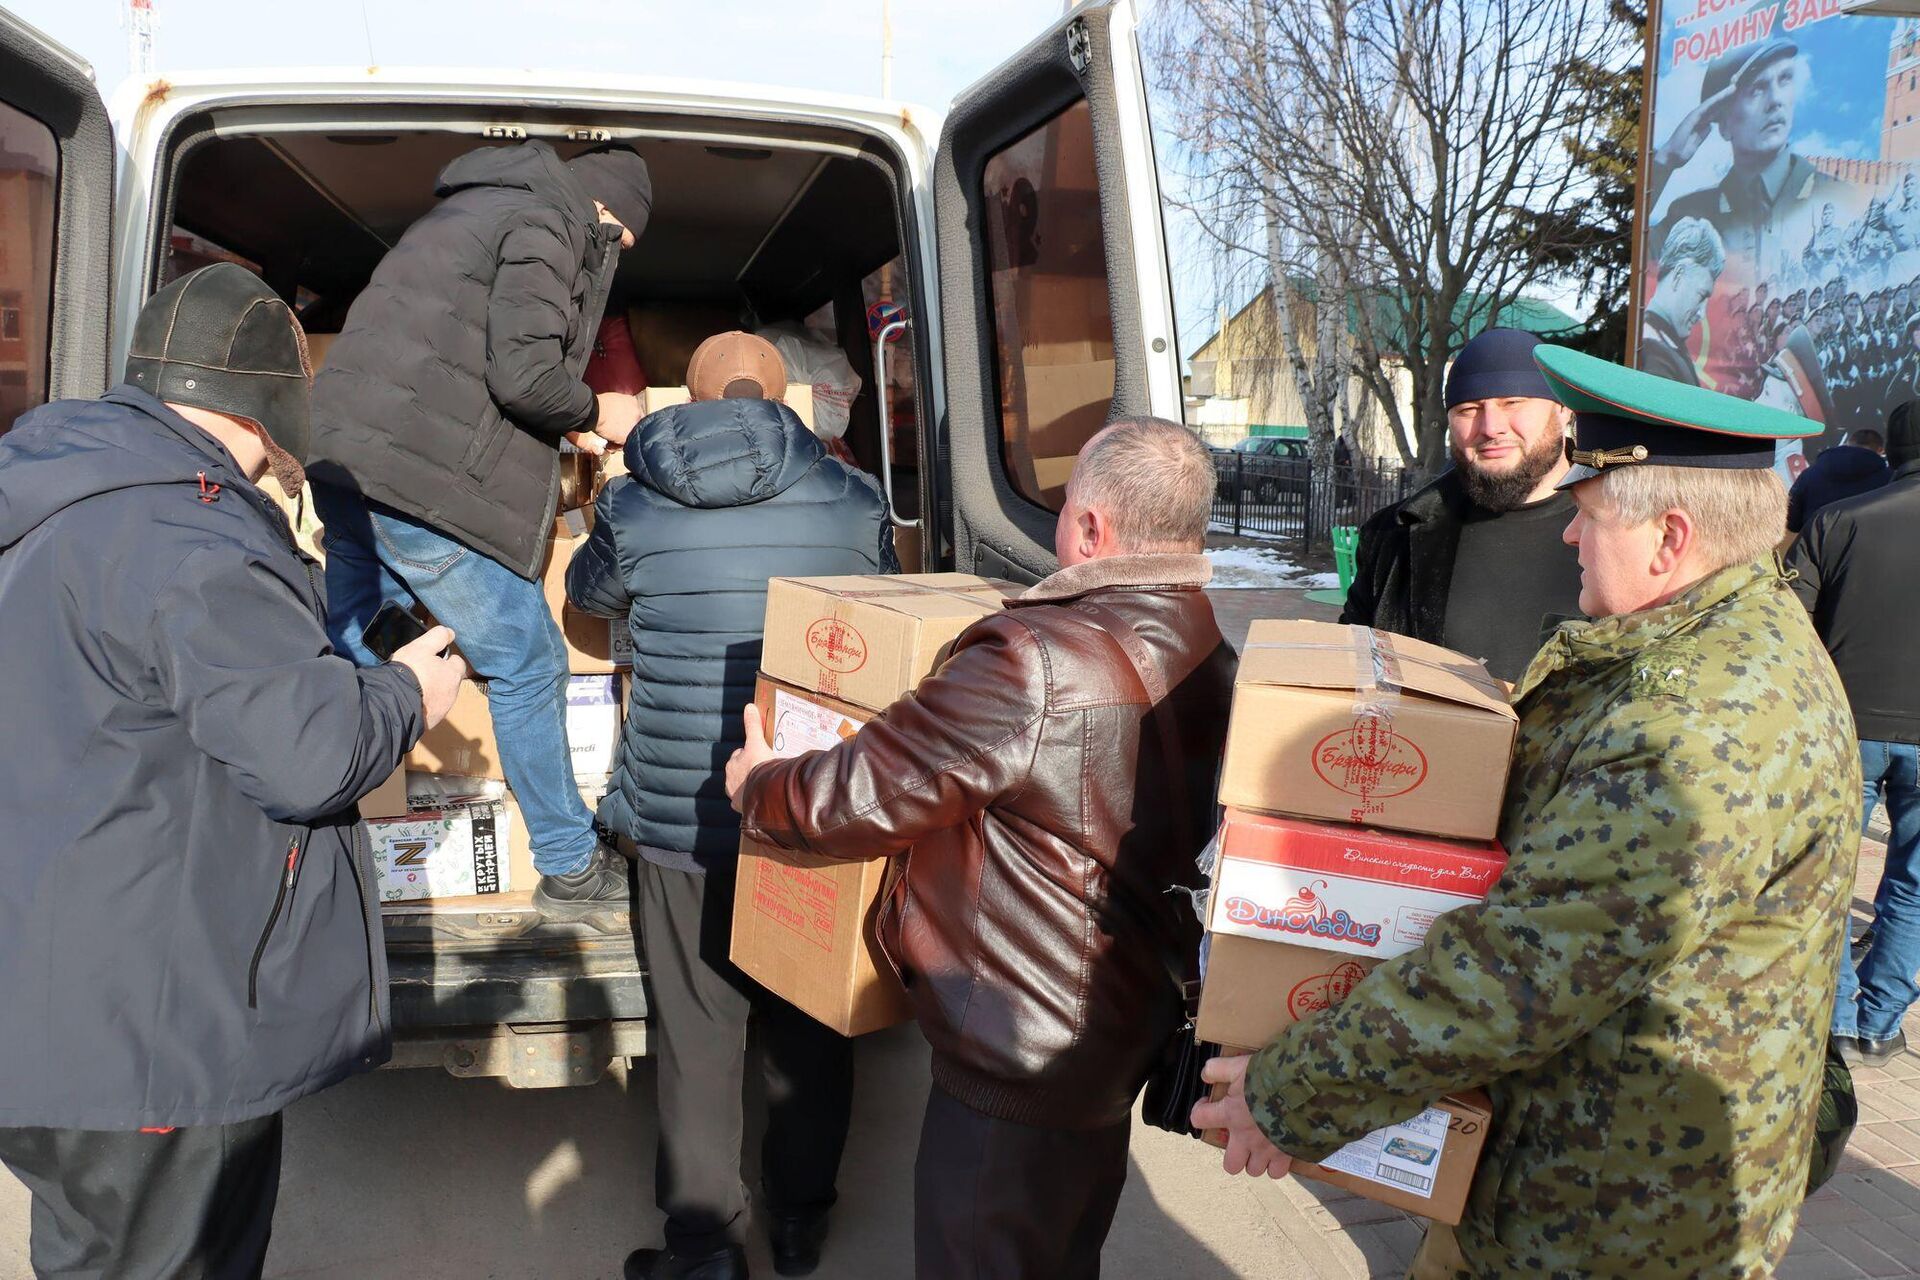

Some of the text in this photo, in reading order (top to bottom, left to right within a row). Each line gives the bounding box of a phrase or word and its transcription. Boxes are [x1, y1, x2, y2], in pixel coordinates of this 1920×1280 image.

[1673, 6, 1778, 66] РОДИНУ
[474, 836, 487, 883] КРУТЫХ
[1391, 860, 1434, 875] сладости
[1431, 868, 1456, 879] для
[1459, 865, 1490, 881] Вас!
[1225, 896, 1381, 947] Динсладия
[1447, 1117, 1478, 1134] 20
